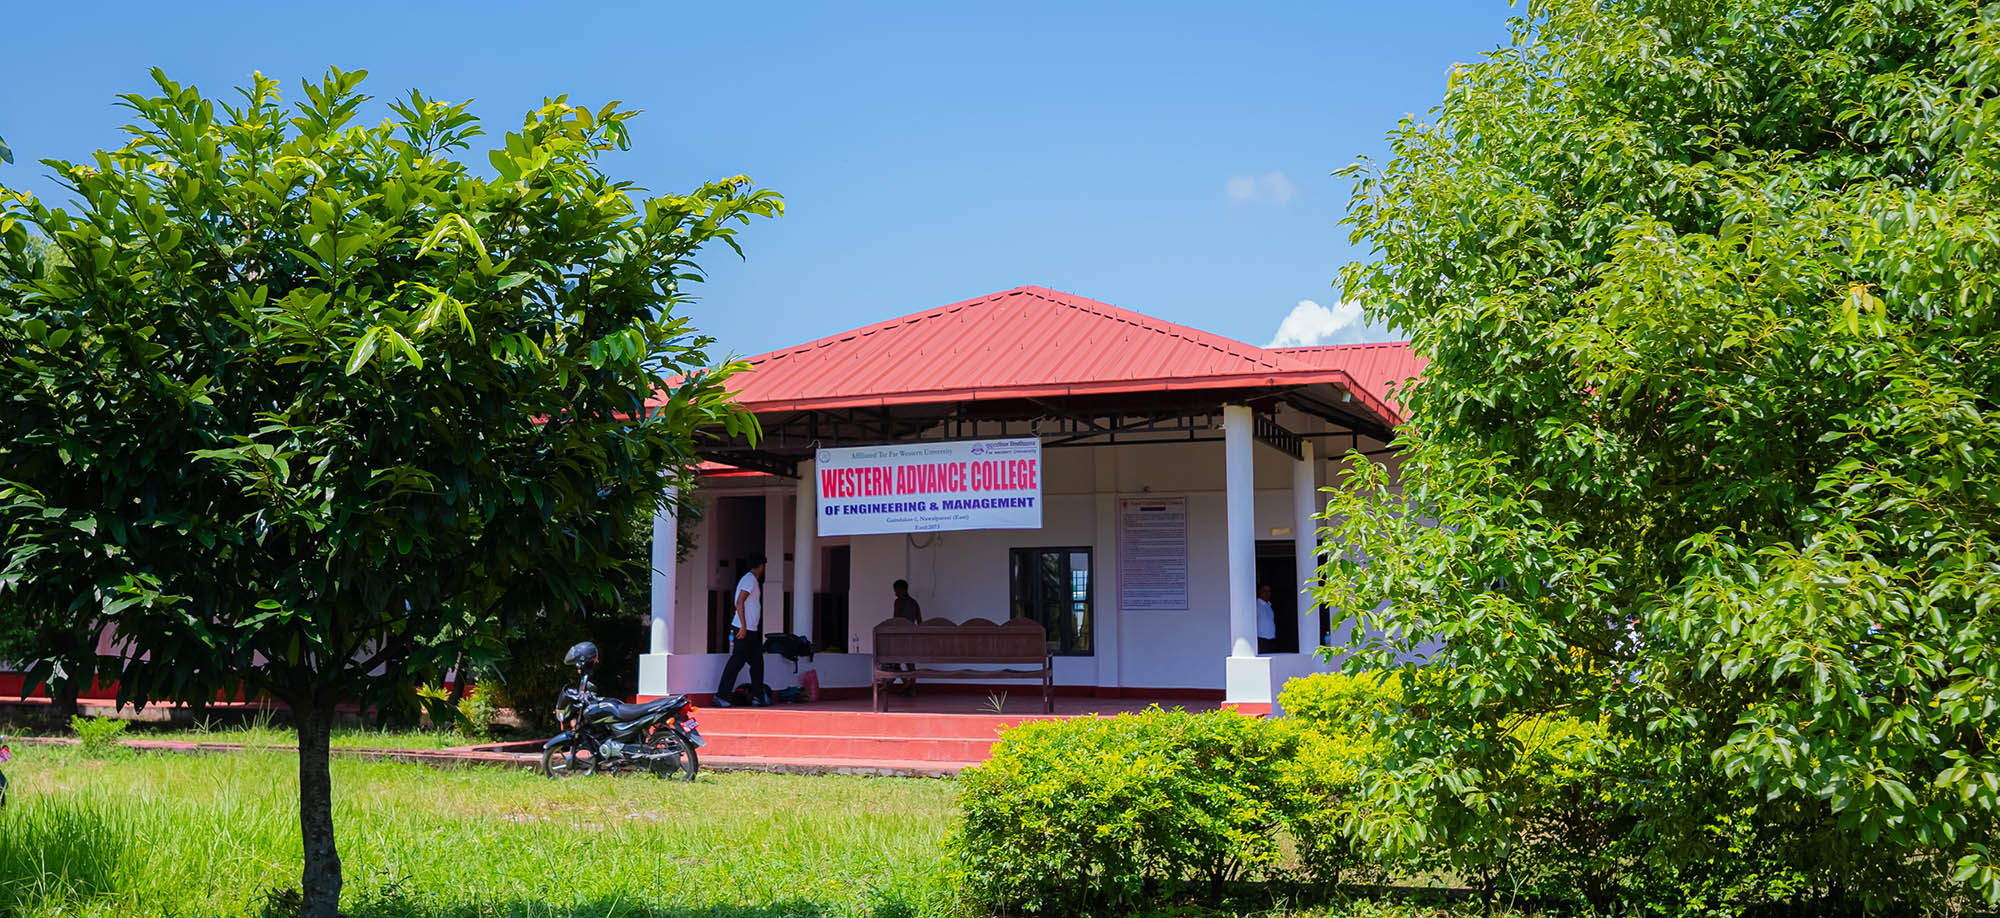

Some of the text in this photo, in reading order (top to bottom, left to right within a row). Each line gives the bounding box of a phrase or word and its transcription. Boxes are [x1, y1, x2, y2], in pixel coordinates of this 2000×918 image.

[821, 459, 1037, 498] WESTERN ADVANCE COLLEGE
[825, 497, 1035, 516] OF ENGINEERING & MANAGEMENT
